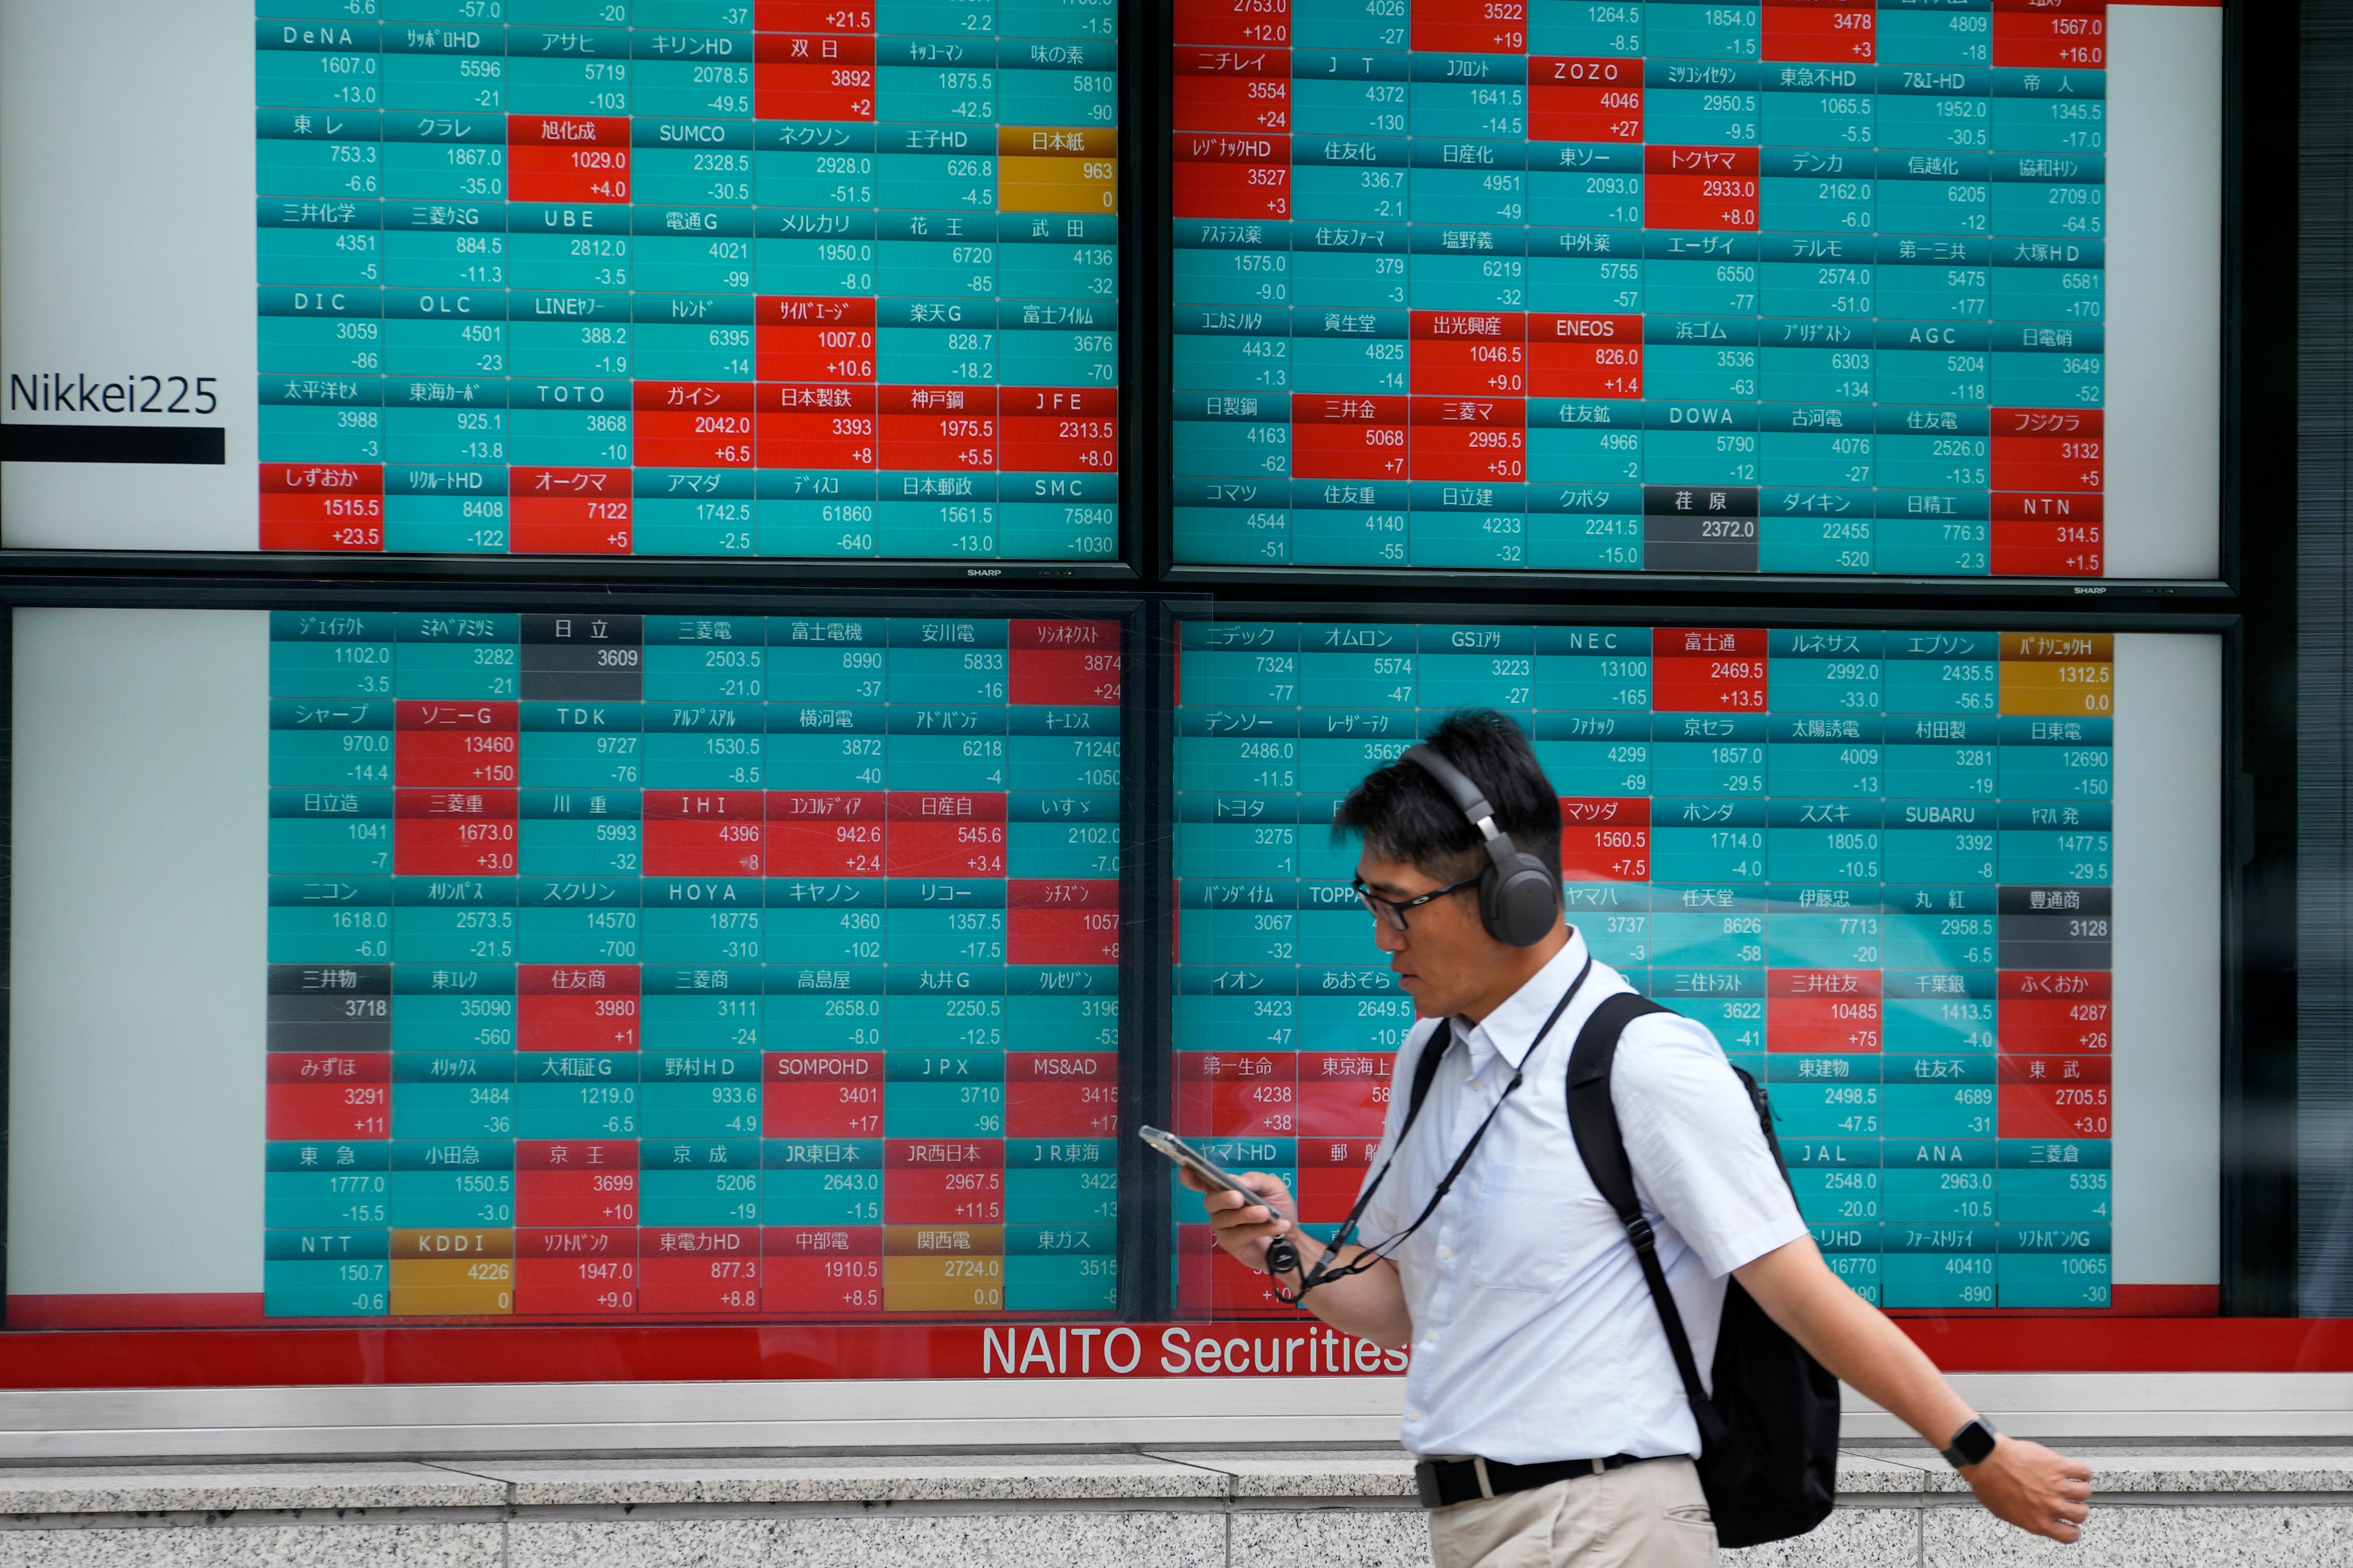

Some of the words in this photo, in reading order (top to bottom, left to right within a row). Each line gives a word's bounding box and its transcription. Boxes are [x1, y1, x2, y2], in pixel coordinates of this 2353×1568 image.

[543, 33, 594, 52] アサヒ
[653, 35, 732, 55] キリンHD
[1198, 52, 1265, 71] ニチレイ
[585, 64, 625, 81] 5719
[694, 66, 748, 84] 2078.5
[1780, 67, 1856, 86] 東急不HD
[1903, 72, 1965, 89] 7&I-HD
[1248, 82, 1286, 99] 3554
[589, 93, 625, 109] -103
[707, 95, 748, 112] -49.5
[1821, 98, 1870, 115] 1065.5
[1937, 101, 1986, 118] 1952.0
[418, 118, 471, 137] クラレ
[1257, 111, 1286, 127] +24
[541, 120, 596, 141] 旭化成
[660, 125, 725, 142] SUMCO
[779, 126, 850, 146] ネクソン
[1947, 129, 1986, 145] -30.5
[447, 148, 501, 166] 1867.0
[1324, 141, 1376, 161] 住友化
[1560, 147, 1610, 167] 東ソー
[572, 151, 626, 169] 1029.0
[694, 154, 748, 171] 2328.5
[816, 156, 870, 174] 2928.0
[1673, 150, 1736, 170] トクヤマ
[460, 178, 502, 195] -35.0
[1361, 171, 1404, 188] 336.7
[1586, 177, 1638, 194] 2093.0
[590, 181, 626, 197] +4.0
[707, 183, 749, 200] -30.5
[830, 186, 870, 203] -51.5
[1703, 180, 1755, 197] 2933.0
[781, 214, 849, 233] メルカリ
[1721, 208, 1755, 225] +8.0
[818, 244, 871, 261] 1950.0
[1793, 240, 1842, 257] テルモ
[841, 273, 871, 290] -8.0
[1818, 268, 1870, 285] 2574.0
[1325, 313, 1376, 332] 資生堂
[1434, 316, 1501, 335] 出光興産
[1557, 320, 1614, 337] ENEOS
[948, 334, 992, 350] 828.7
[1365, 344, 1404, 360] 4825
[1470, 346, 1521, 363] 1046.5
[1596, 348, 1638, 365] 826.0
[952, 362, 992, 379] -18.2
[1488, 374, 1521, 391] +9.0
[1605, 377, 1638, 393] +1.4
[10, 373, 217, 414] Nikkei225
[667, 386, 721, 406] ガイシ
[782, 388, 852, 407] 日本製鉄
[911, 389, 964, 409] 神戸鋼
[1207, 397, 1257, 416] 日製鋼
[695, 416, 750, 433] 2042.0
[833, 418, 872, 435] 3393
[940, 420, 993, 437] 1975.5
[2015, 414, 2079, 432] フジクラ
[1247, 427, 1285, 443] 4163
[715, 445, 750, 462] +6.5
[2062, 442, 2099, 459] 3132
[286, 468, 358, 487] しずおか
[904, 477, 972, 495] 日本郵政
[1207, 485, 1256, 502] コマツ
[1560, 489, 1610, 508] クボタ
[323, 499, 379, 516] 1515.5
[1783, 494, 1850, 512] ダイキン
[940, 506, 992, 523] 1561.5
[1247, 513, 1285, 529] 4544
[1586, 519, 1637, 535] 2241.5
[1702, 521, 1754, 538] 2372.0
[1823, 523, 1869, 539] 22455
[333, 528, 379, 545] +23.5
[952, 535, 992, 551] -13.0
[1598, 547, 1637, 563] -15.0
[1835, 551, 1869, 567] -520
[678, 621, 732, 640] 三菱電
[1325, 628, 1393, 647] オムロン
[1685, 632, 1736, 651] 富士通
[706, 651, 760, 667] 2503.5
[1374, 658, 1412, 674] 5574
[1711, 662, 1763, 679] 2469.5
[720, 679, 760, 696] -21.0
[1387, 686, 1412, 702] -47
[1720, 690, 1763, 706] +13.5
[296, 706, 368, 723] シャープ
[422, 706, 491, 724] ソニーG
[2032, 722, 2081, 741] 日東電
[343, 735, 389, 752] 970.0
[464, 736, 514, 752] 13460
[2063, 751, 2108, 767] 12690
[347, 765, 388, 780] -14.4
[473, 765, 514, 781] +150
[2074, 779, 2108, 794] -150
[430, 794, 483, 812] 三菱重
[922, 796, 972, 816] 日産自
[1218, 799, 1264, 817] トヨタ
[1567, 801, 1619, 820] マツダ
[1906, 807, 1974, 823] SUBARU
[459, 824, 513, 840] 1673.0
[958, 827, 1001, 843] 545.6
[1255, 828, 1292, 844] 3275
[1595, 831, 1646, 848] 1560.5
[1956, 835, 1992, 851] 3392
[477, 853, 513, 869] +3.0
[967, 855, 1001, 871] +3.4
[1612, 859, 1646, 876] +7.5
[544, 883, 615, 900] スクリン
[790, 883, 860, 902] キヤノン
[1683, 889, 1734, 907] 任天堂
[2030, 890, 2080, 909] 豊通商
[588, 912, 635, 928] 14570
[840, 913, 880, 929] 4360
[1723, 917, 1762, 934] 8626
[2070, 920, 2107, 936] 3128
[600, 941, 635, 957] -700
[844, 941, 880, 958] -102
[552, 969, 606, 988] 住友商
[1213, 970, 1264, 989] イオン
[1323, 971, 1390, 990] あおぞら
[1791, 973, 1858, 993] 三井住友
[595, 1000, 635, 1016] 3980
[1254, 1001, 1292, 1017] 3423
[1358, 1001, 1410, 1017] 2649.5
[1831, 1003, 1877, 1019] 10485
[1849, 1030, 1877, 1047] +75
[778, 1058, 868, 1075] SOMPOHD
[1204, 1055, 1272, 1075] 第一生命
[1798, 1058, 1849, 1078] 東建物
[839, 1087, 876, 1103] 3401
[1253, 1086, 1292, 1102] 4238
[1825, 1088, 1877, 1104] 2498.5
[849, 1115, 879, 1132] +17
[1838, 1115, 1877, 1132] -47.5
[425, 1145, 479, 1164] 小田急
[785, 1144, 860, 1163] JR東日本
[907, 1144, 981, 1162] JR西日本
[455, 1176, 510, 1192] 1550.5
[824, 1173, 878, 1190] 2643.0
[946, 1173, 999, 1190] 2967.5
[1941, 1173, 1992, 1189] 2963.0
[955, 1202, 999, 1218] +11.5
[1954, 1201, 1992, 1217] -10.5
[917, 1231, 971, 1249] 関西電
[944, 1260, 999, 1277] 2724.0
[1945, 1258, 1992, 1274] 40410
[1958, 1286, 1992, 1302] -890
[983, 1327, 1141, 1374] NAITO
[1160, 1327, 1409, 1373] Securities
